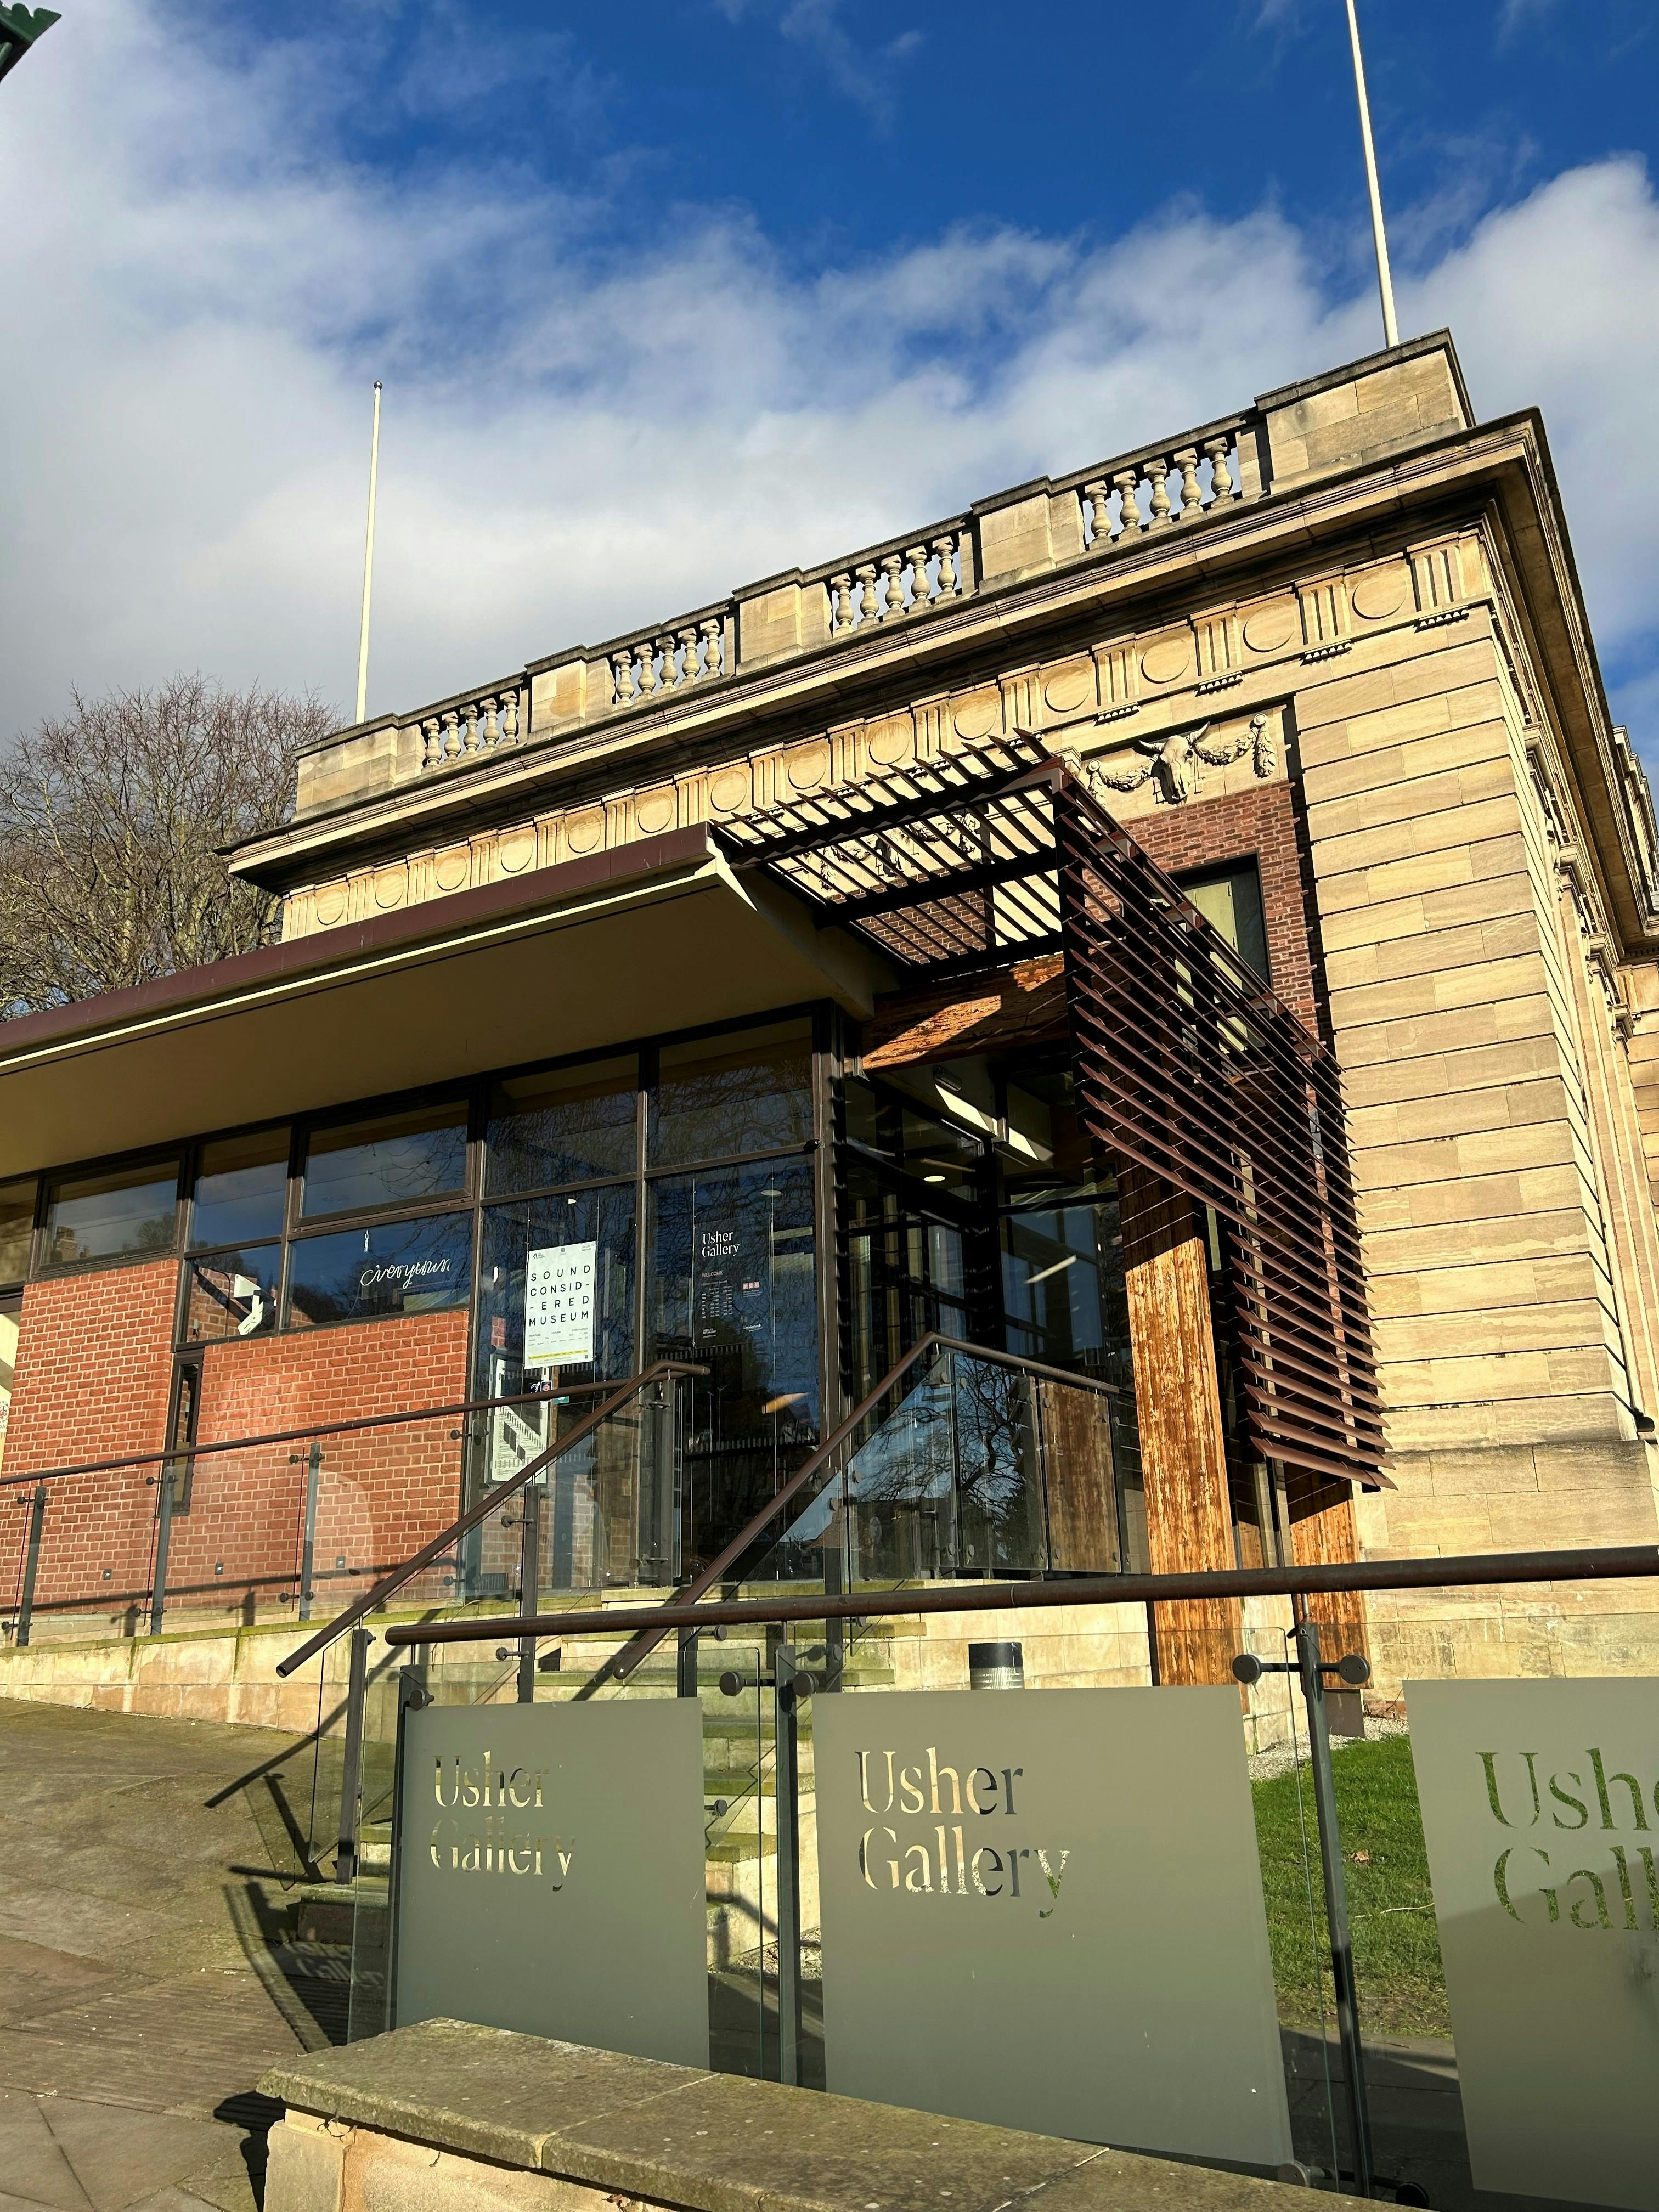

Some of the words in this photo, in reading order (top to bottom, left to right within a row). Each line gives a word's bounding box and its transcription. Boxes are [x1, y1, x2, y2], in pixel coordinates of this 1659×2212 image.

[702, 1231, 733, 1245] Usher
[702, 1243, 740, 1257] Gallery
[531, 1265, 591, 1282] SOUND
[530, 1281, 590, 1297] CONSID-
[529, 1295, 589, 1310] -ERED
[528, 1310, 589, 1327] MUSEUM
[433, 1751, 549, 1808] Usher
[854, 1747, 1023, 1815] Usher
[1475, 1747, 1659, 1831] Ush
[430, 1816, 575, 1892] Gallery
[859, 1825, 1070, 1919] Gallery
